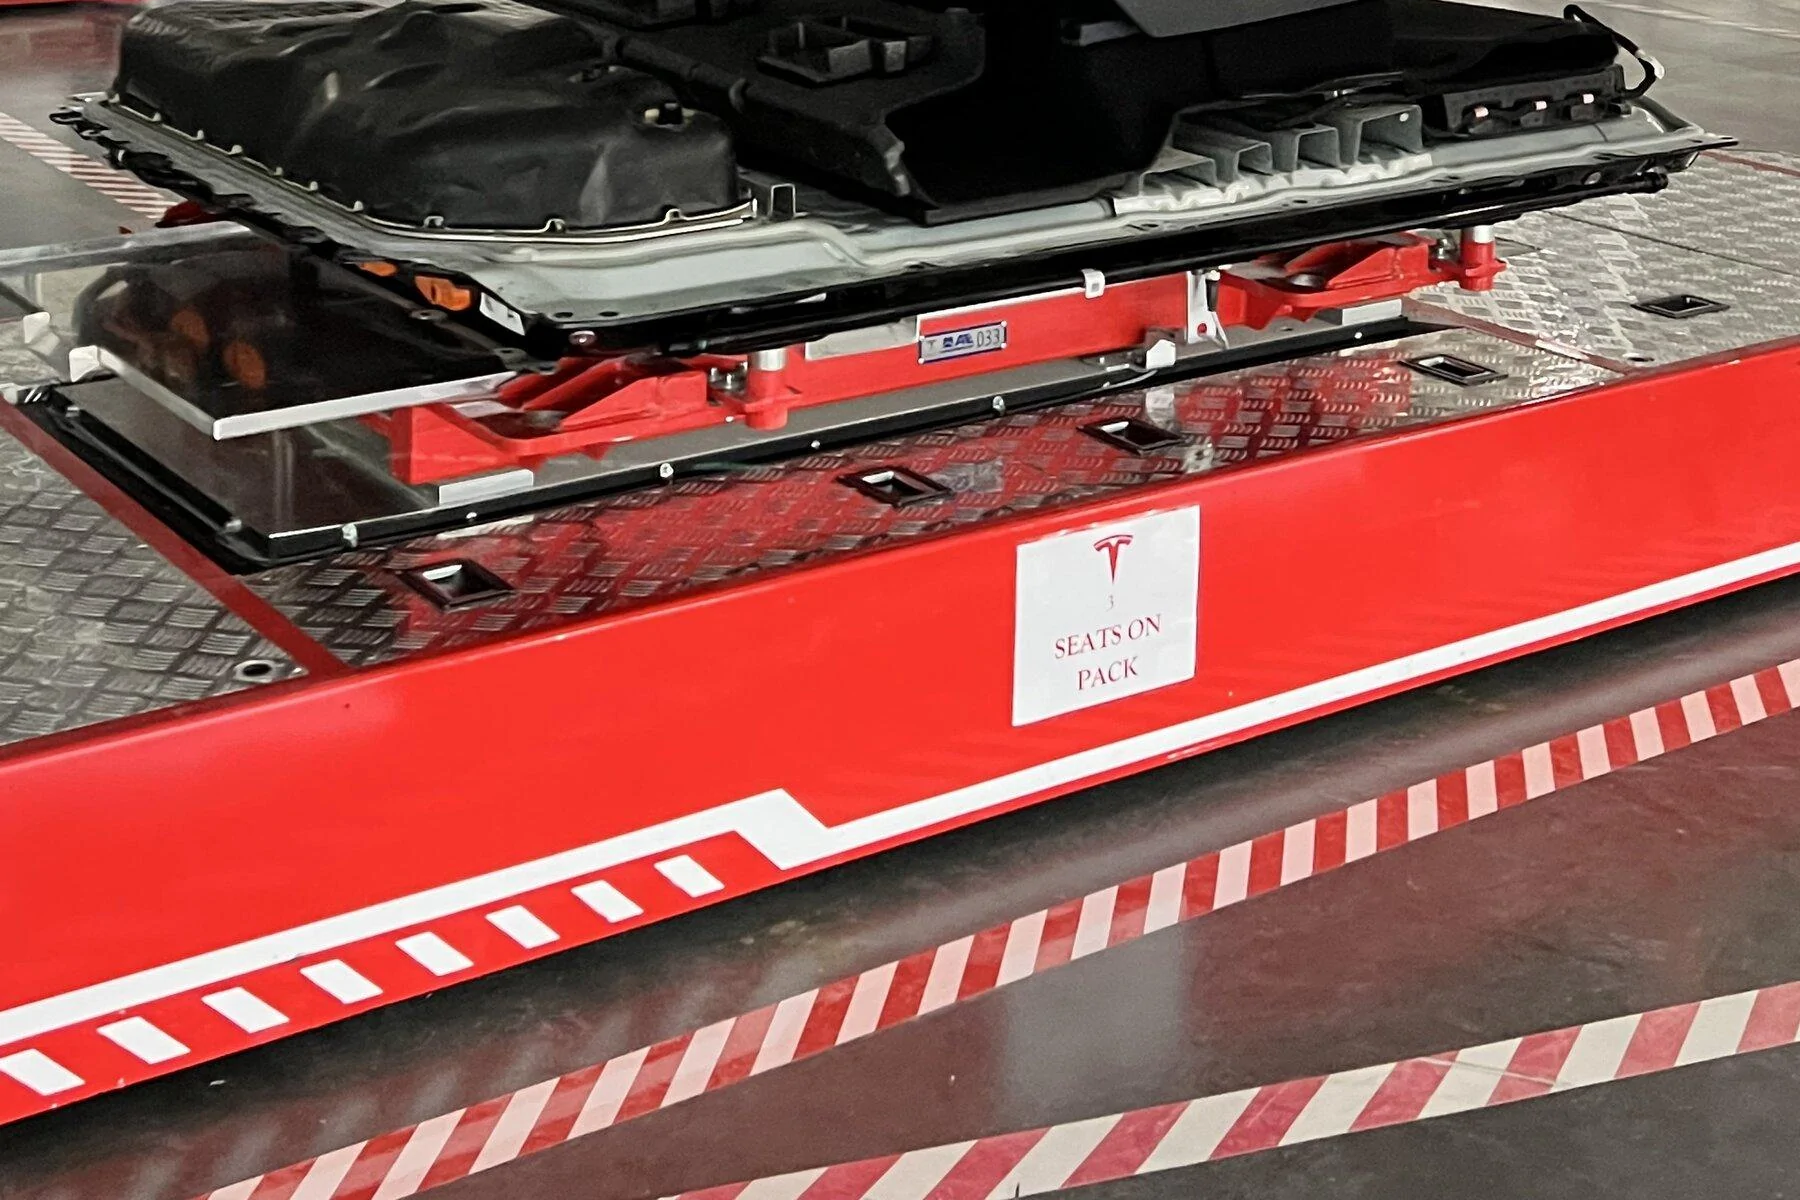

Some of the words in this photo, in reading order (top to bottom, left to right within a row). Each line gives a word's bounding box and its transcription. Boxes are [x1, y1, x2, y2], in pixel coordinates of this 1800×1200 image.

[976, 328, 1001, 348] 033
[1054, 624, 1123, 660] SEATS
[1127, 613, 1162, 641] ON
[1077, 655, 1139, 691] PACK
